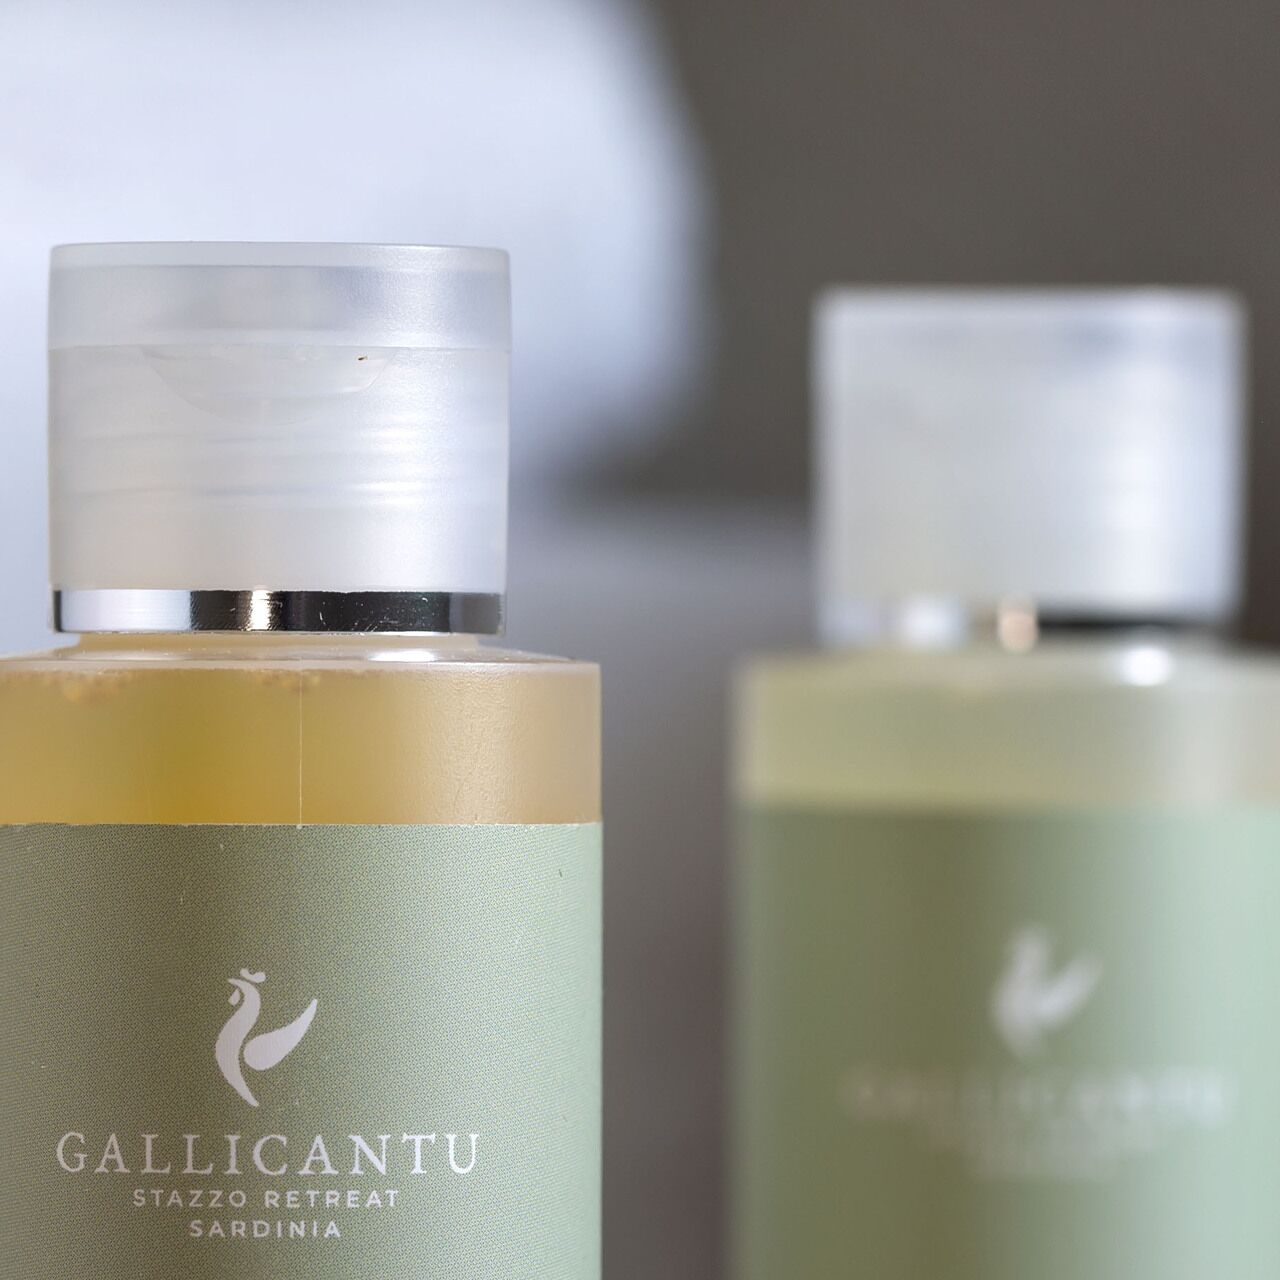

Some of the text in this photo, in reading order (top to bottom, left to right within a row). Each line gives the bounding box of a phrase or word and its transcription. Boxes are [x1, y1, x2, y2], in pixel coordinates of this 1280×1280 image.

[55, 1131, 480, 1176] GALLICANTU
[132, 1189, 400, 1208] STAZZO RETREAT
[189, 1220, 342, 1238] SARDINIA
